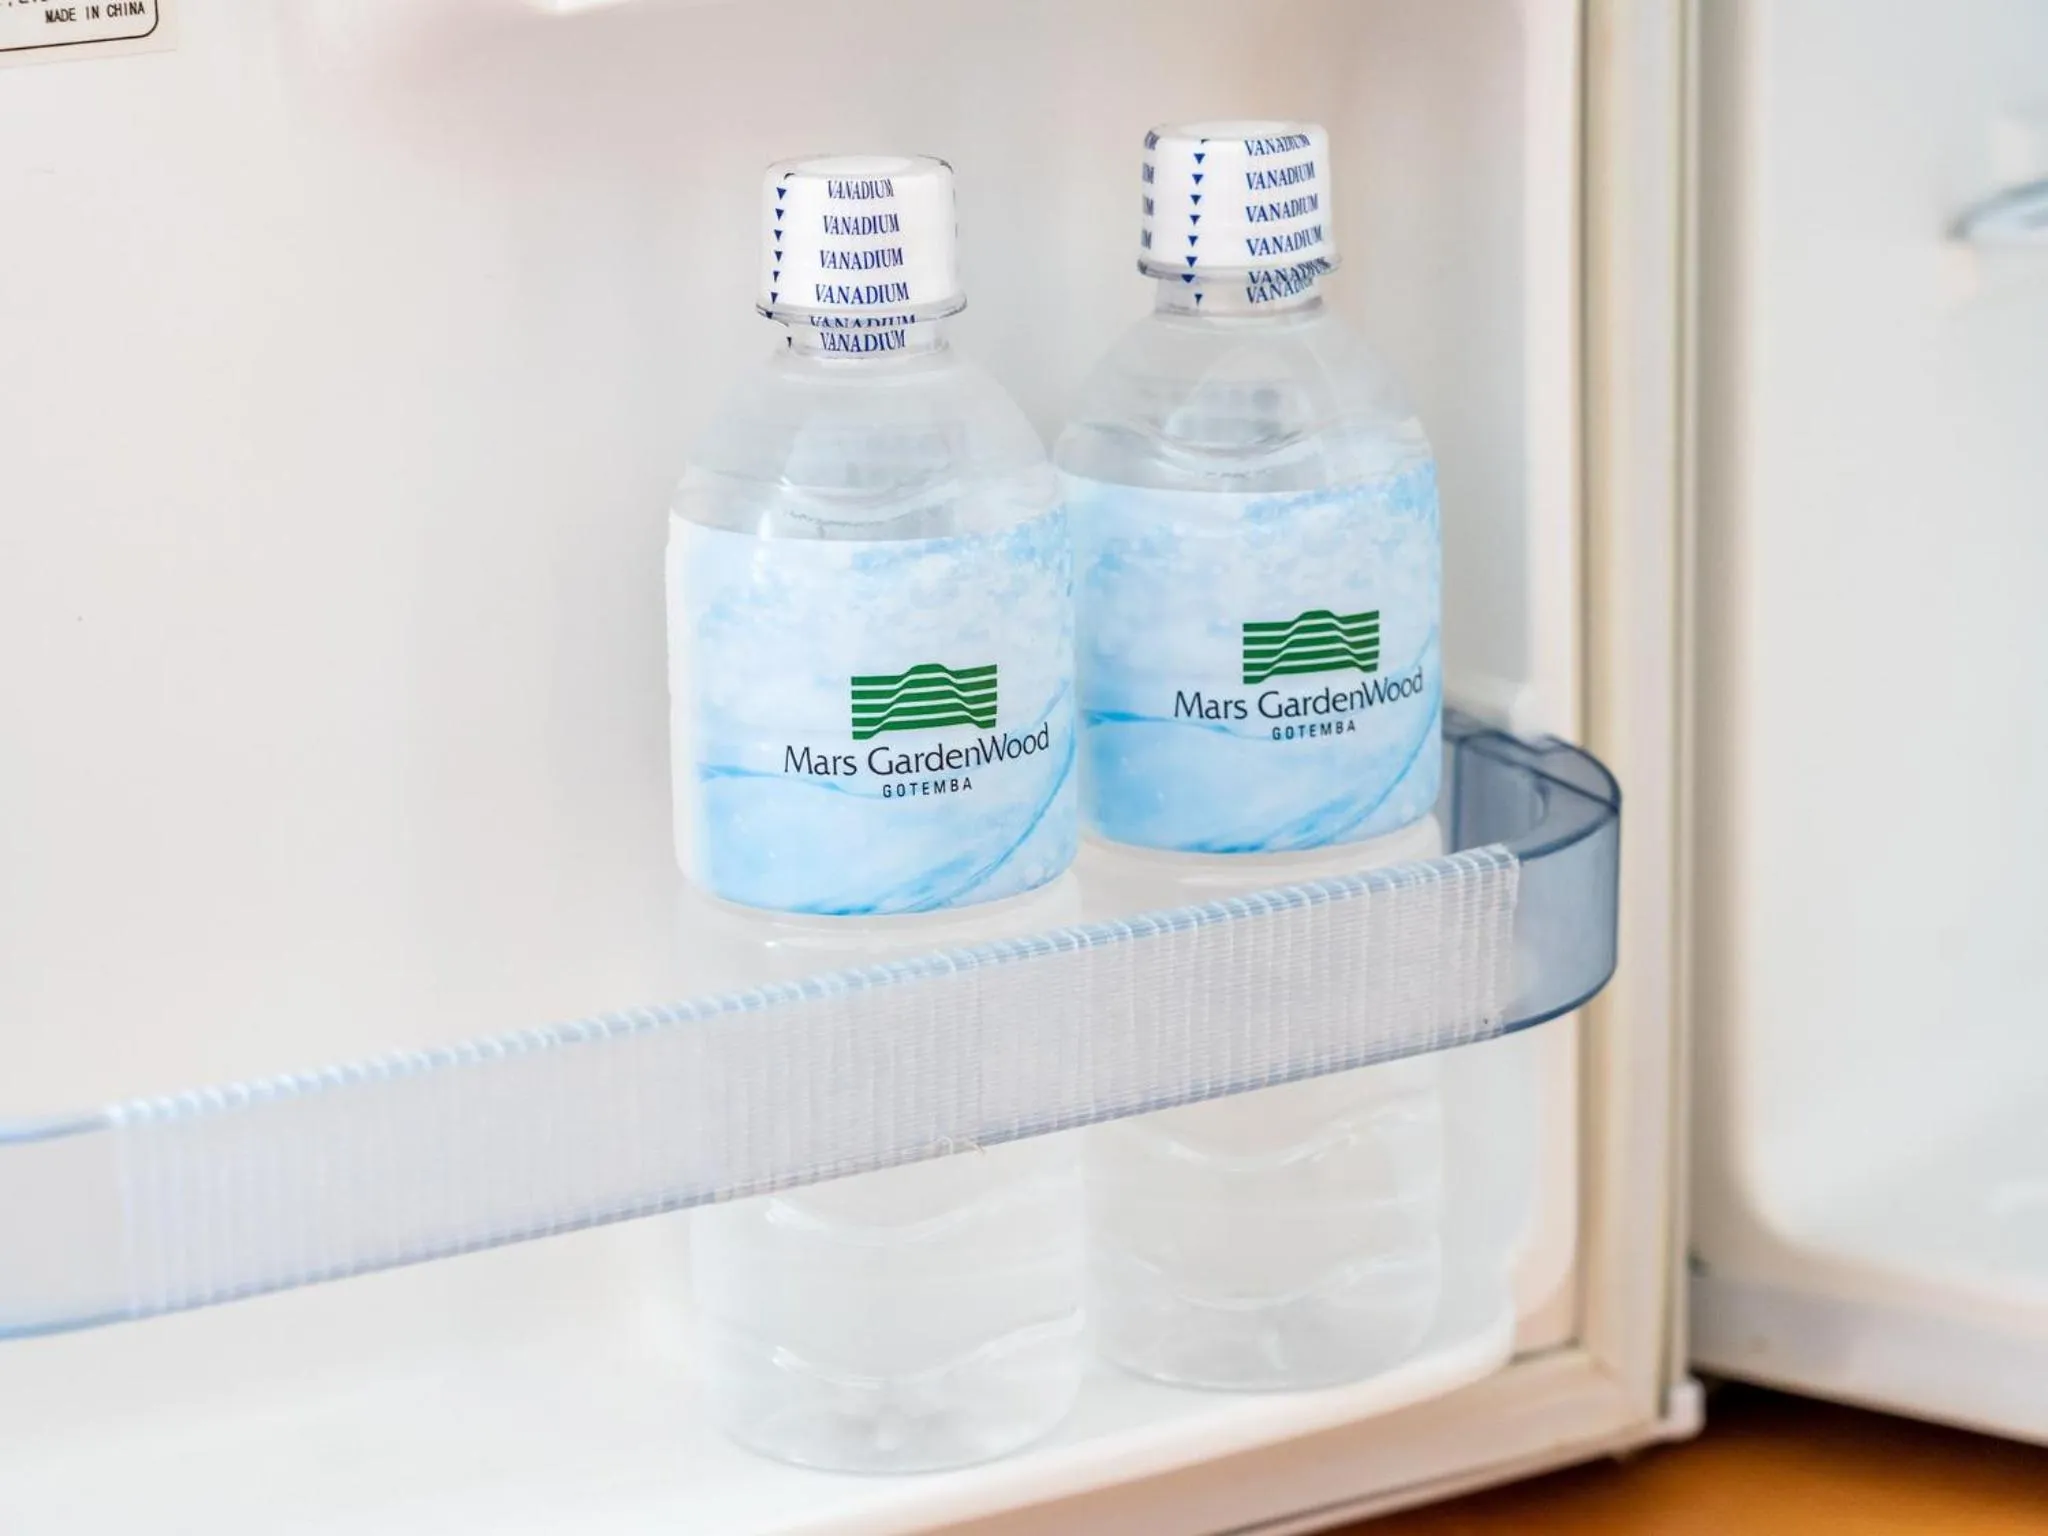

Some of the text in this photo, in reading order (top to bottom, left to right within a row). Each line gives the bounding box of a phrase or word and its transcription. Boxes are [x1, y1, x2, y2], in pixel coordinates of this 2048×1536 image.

[45, 1, 145, 23] MADE IN CHINA
[1244, 133, 1311, 156] VANADIUM
[1245, 161, 1316, 190] VANADIUM
[827, 178, 894, 200] VANADIUM
[1245, 192, 1319, 223] VANADIUM
[823, 213, 900, 235] VANADIUM
[1245, 224, 1323, 256] VANADIUM
[819, 247, 904, 270] VANADIUM
[815, 281, 909, 304] VANADIUM
[820, 329, 905, 352] VANADIUM
[1174, 666, 1424, 720] Mars GardenWood
[1272, 720, 1356, 741] GOTEMBA
[784, 722, 1050, 776] Mars GardenWood
[882, 777, 973, 798] GOTEMBA
